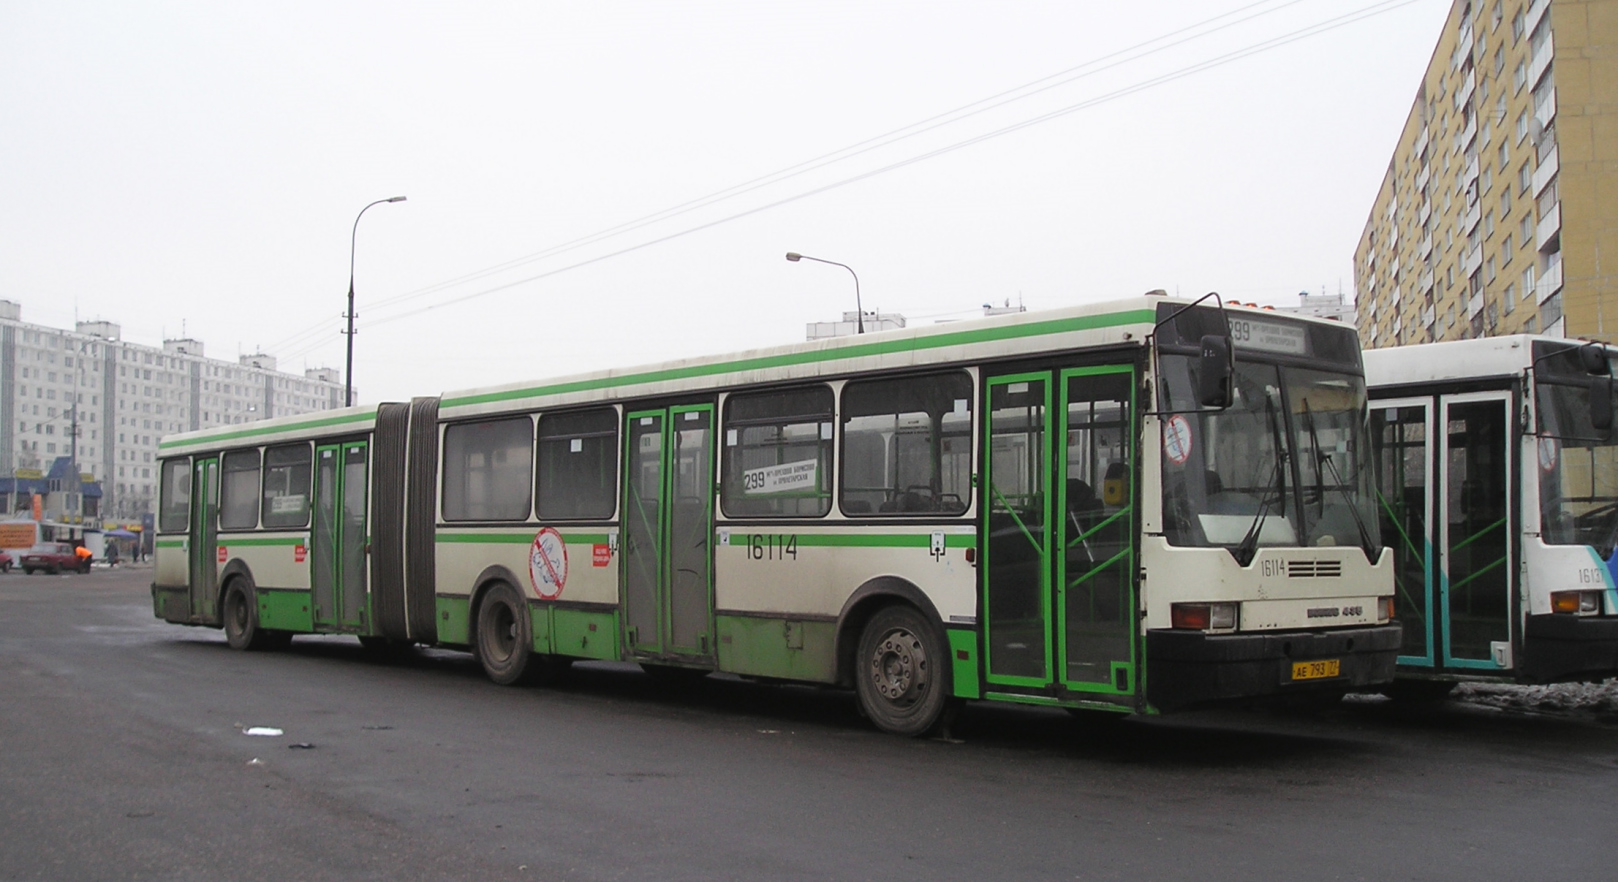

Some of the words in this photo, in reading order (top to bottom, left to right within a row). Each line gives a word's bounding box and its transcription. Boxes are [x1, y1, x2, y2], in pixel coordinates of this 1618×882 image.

[744, 471, 765, 490] 299
[747, 534, 797, 560] 16114
[1261, 559, 1285, 577] 16114
[1579, 568, 1604, 583] 16137
[1310, 662, 1325, 676] 793
